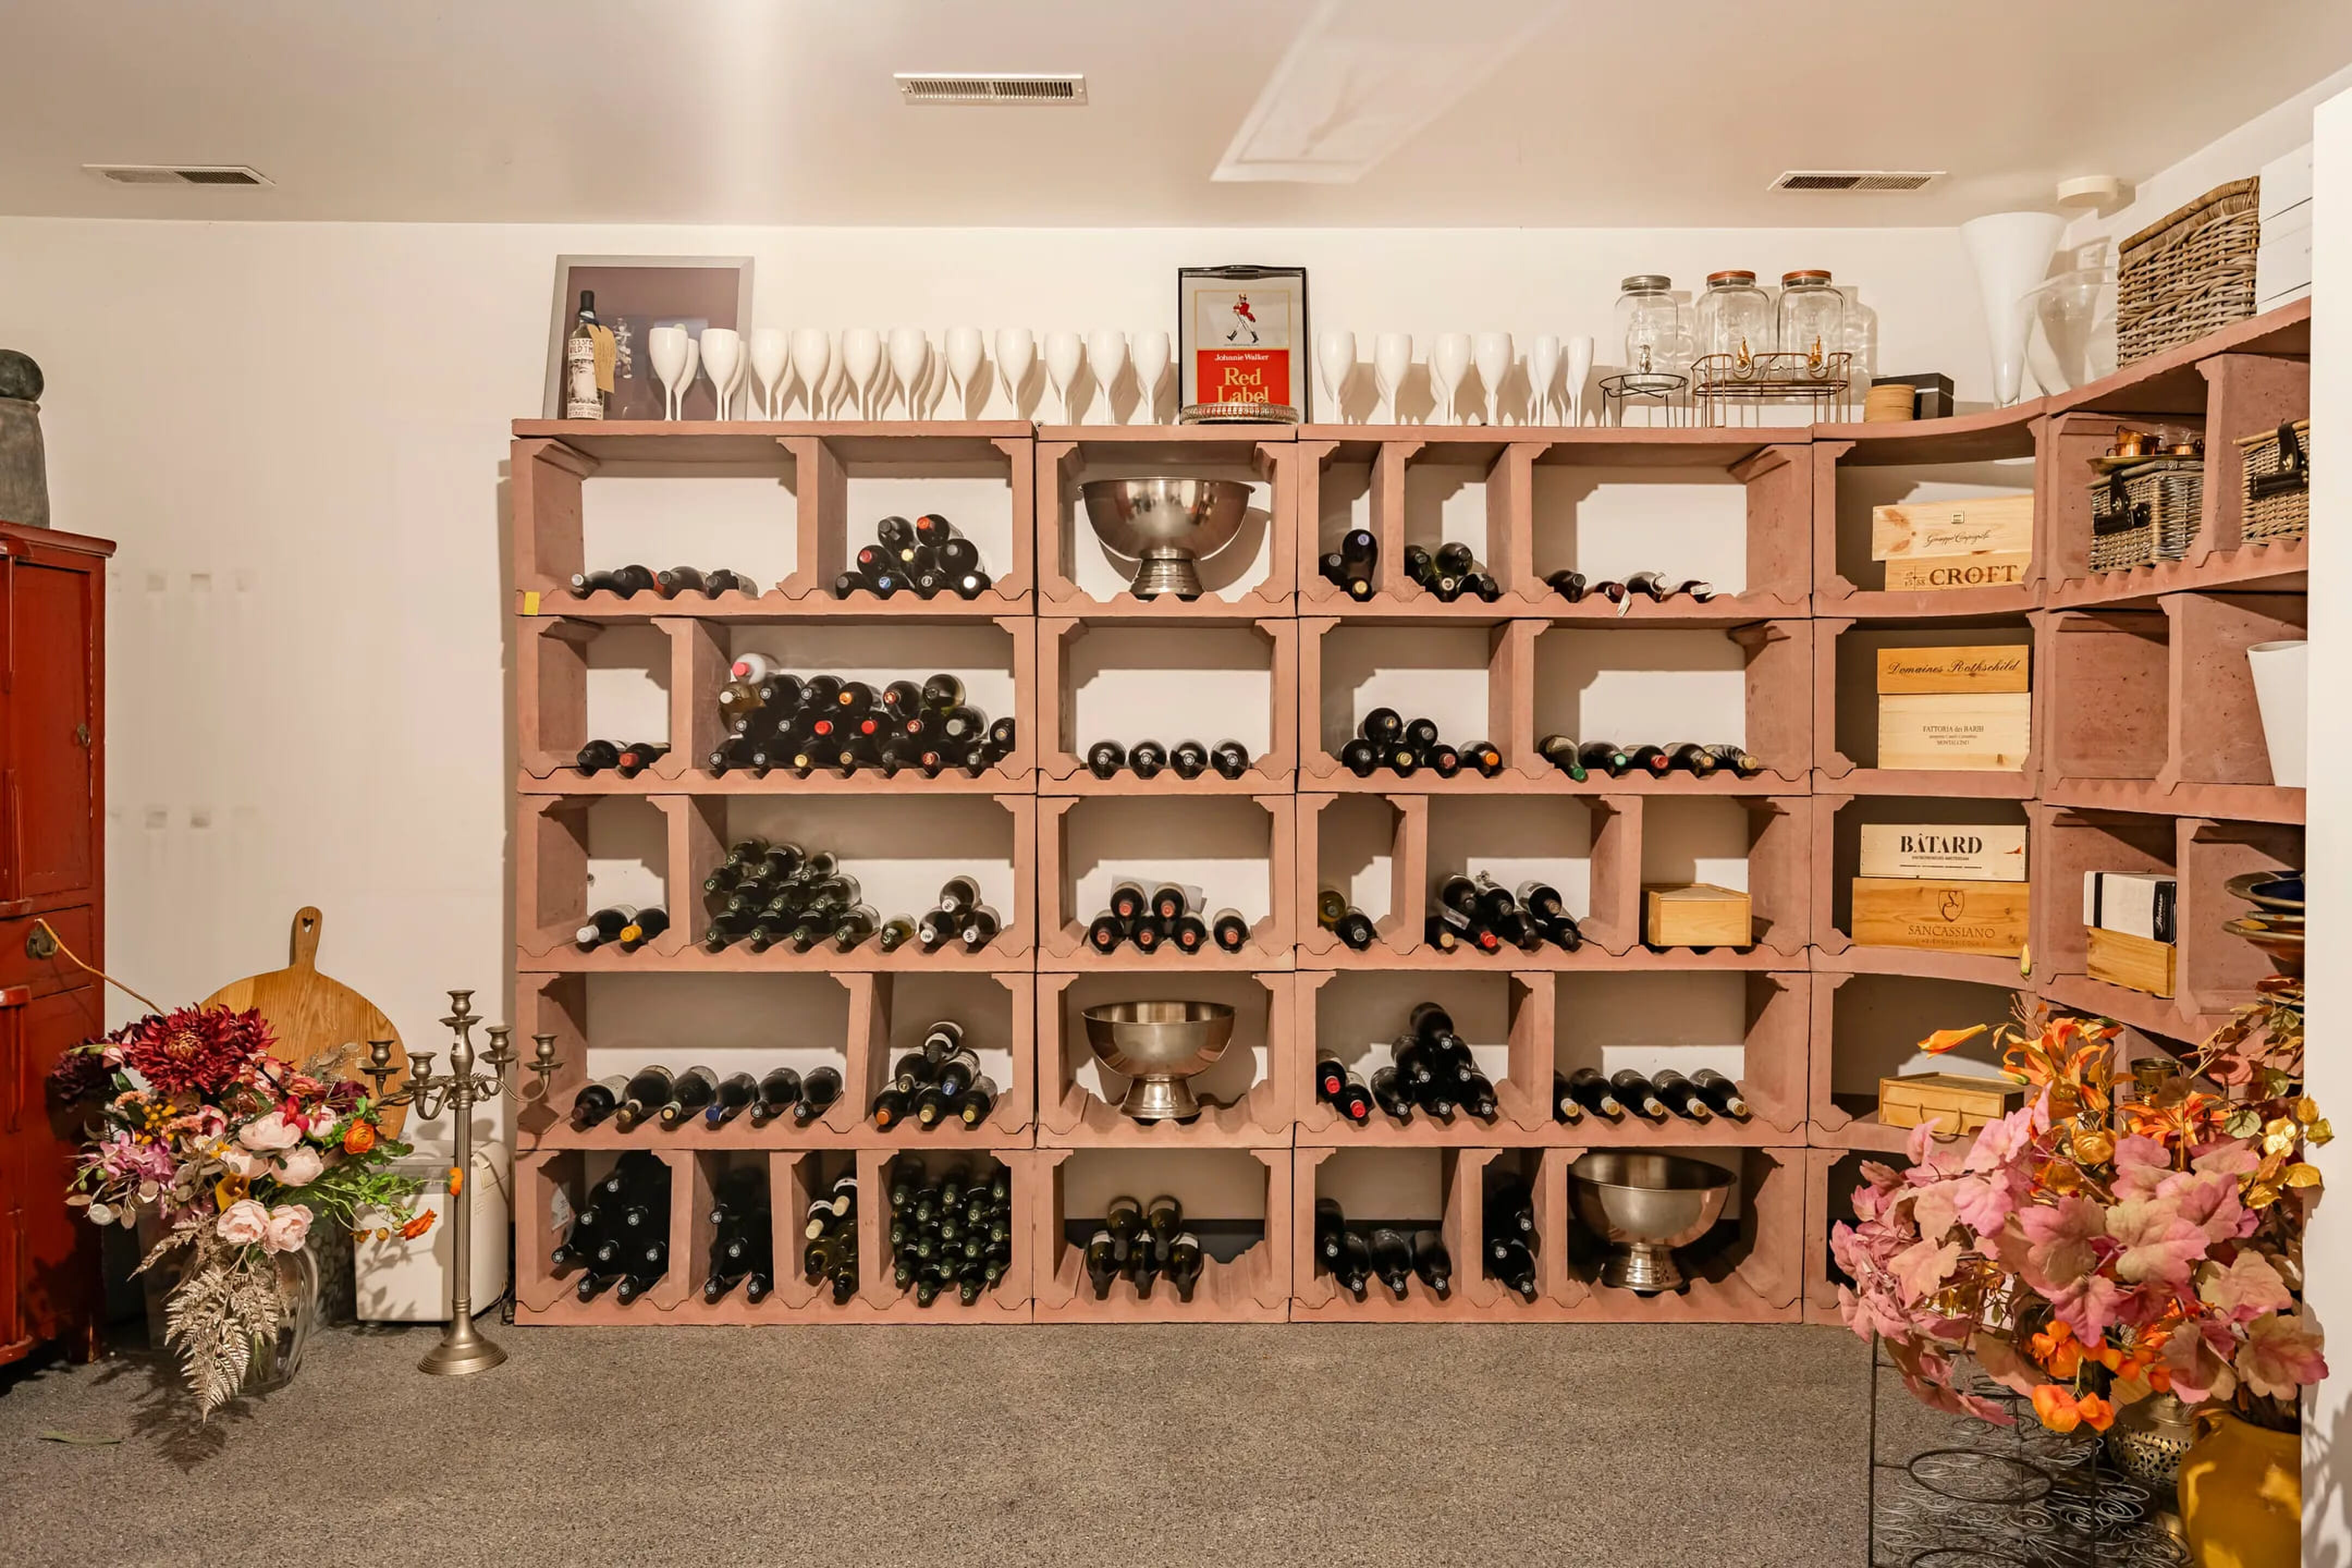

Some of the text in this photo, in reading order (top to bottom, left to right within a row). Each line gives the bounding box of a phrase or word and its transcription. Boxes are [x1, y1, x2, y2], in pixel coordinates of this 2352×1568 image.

[1224, 367, 1261, 386] Red
[1216, 385, 1269, 403] Label
[1929, 565, 2018, 585] CROFT
[1887, 659, 2020, 675] Domaines Rothschild
[1900, 833, 1983, 854] BÂTARD
[1908, 925, 1995, 939] SANCASSIANO
